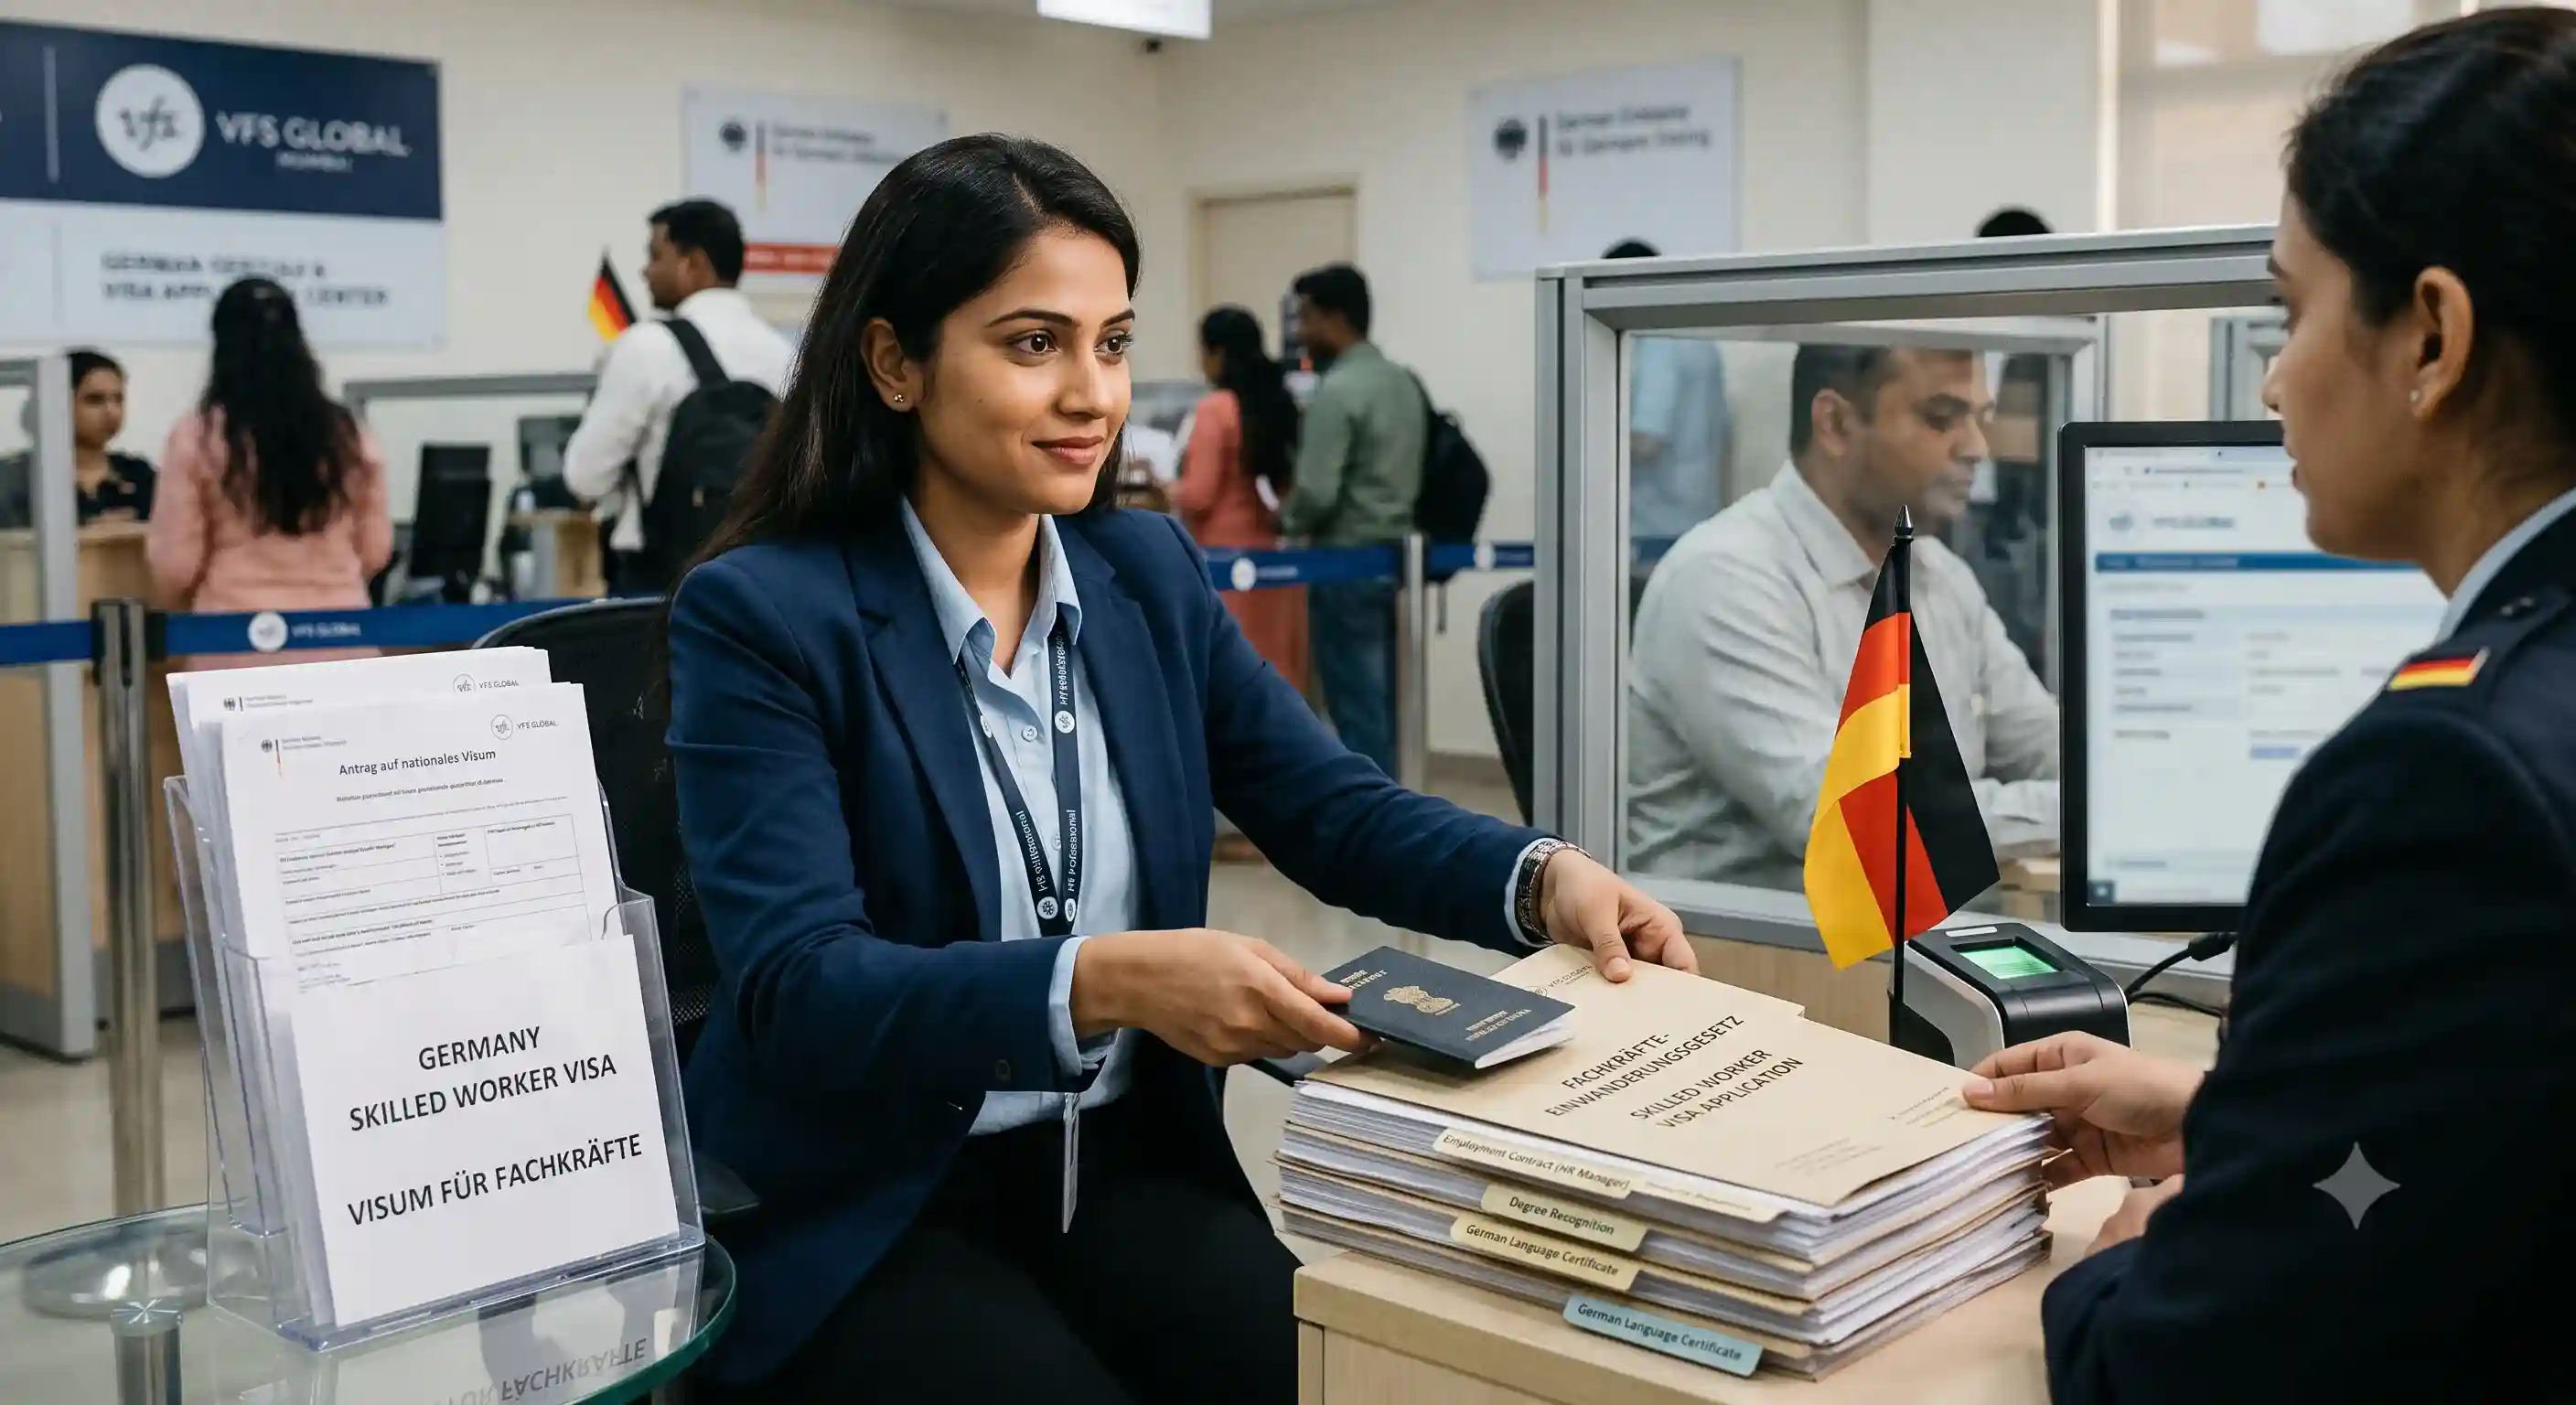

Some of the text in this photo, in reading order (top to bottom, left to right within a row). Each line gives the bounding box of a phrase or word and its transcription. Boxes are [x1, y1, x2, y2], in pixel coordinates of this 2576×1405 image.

[215, 110, 412, 157] VFS GLOBAL
[339, 749, 496, 776] Antrag auf nationales Visum
[419, 1025, 542, 1071] GERMANY
[1544, 1015, 1744, 1116] EINWANDERUNGSGESETZ
[1562, 1034, 1669, 1089] FACHKRÄFTE-
[349, 1054, 617, 1132] SKILLED WORKER VISA
[1630, 1049, 1773, 1121] SKILLED WORKER
[1656, 1057, 1804, 1128] VISA APPLICATION
[348, 1133, 642, 1226] VISUM FÜR FACHKRÄFTE
[1508, 1151, 1554, 1170] Contract
[1509, 1196, 1615, 1235] Degree Recognition
[1466, 1224, 1619, 1277] German Language Certificate
[1578, 1303, 1742, 1360] German Language Certificate
